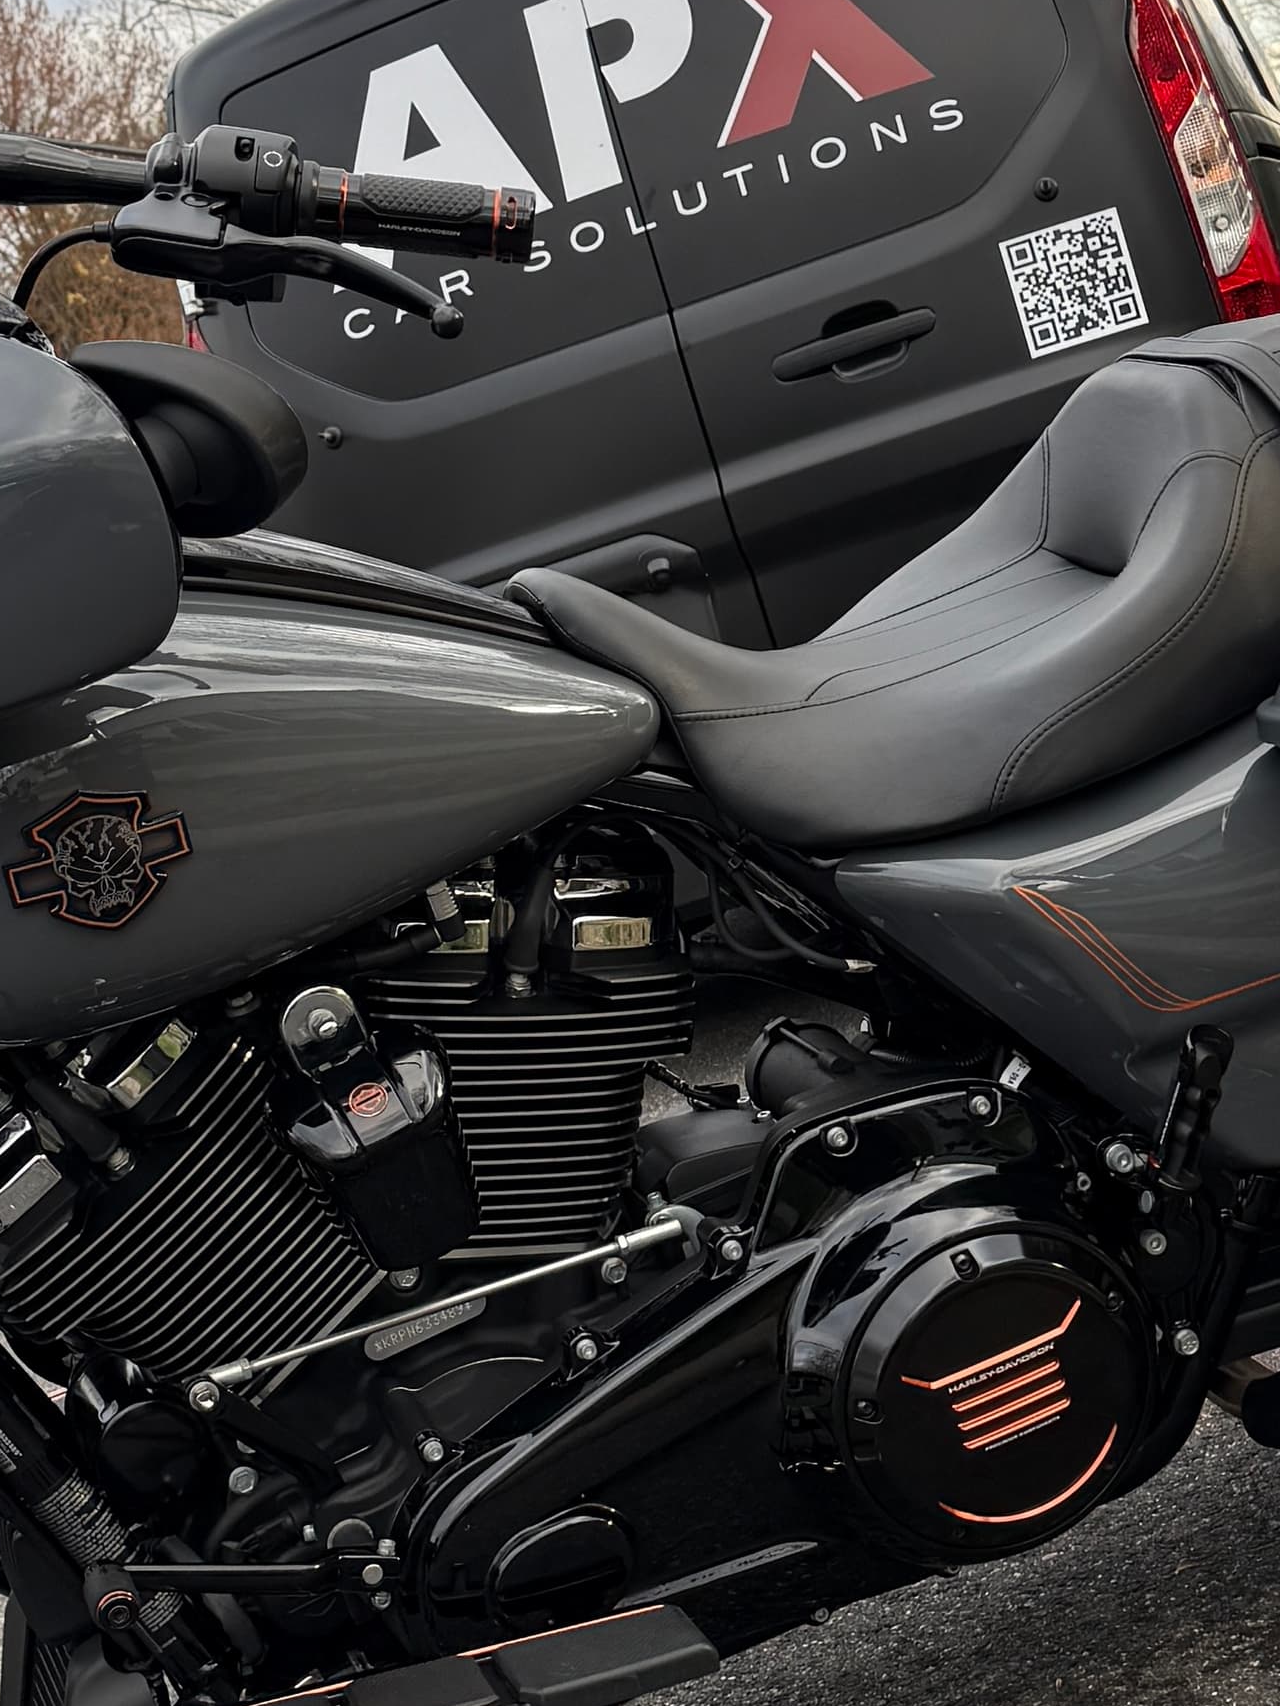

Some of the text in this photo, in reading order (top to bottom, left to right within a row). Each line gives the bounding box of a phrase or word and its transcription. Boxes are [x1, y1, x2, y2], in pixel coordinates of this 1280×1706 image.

[342, 98, 964, 340] CR SOLUTIONS
[377, 222, 461, 237] HARLEY-DAVIDSON
[948, 1341, 1055, 1395] HARLEY-DAVIDSON
